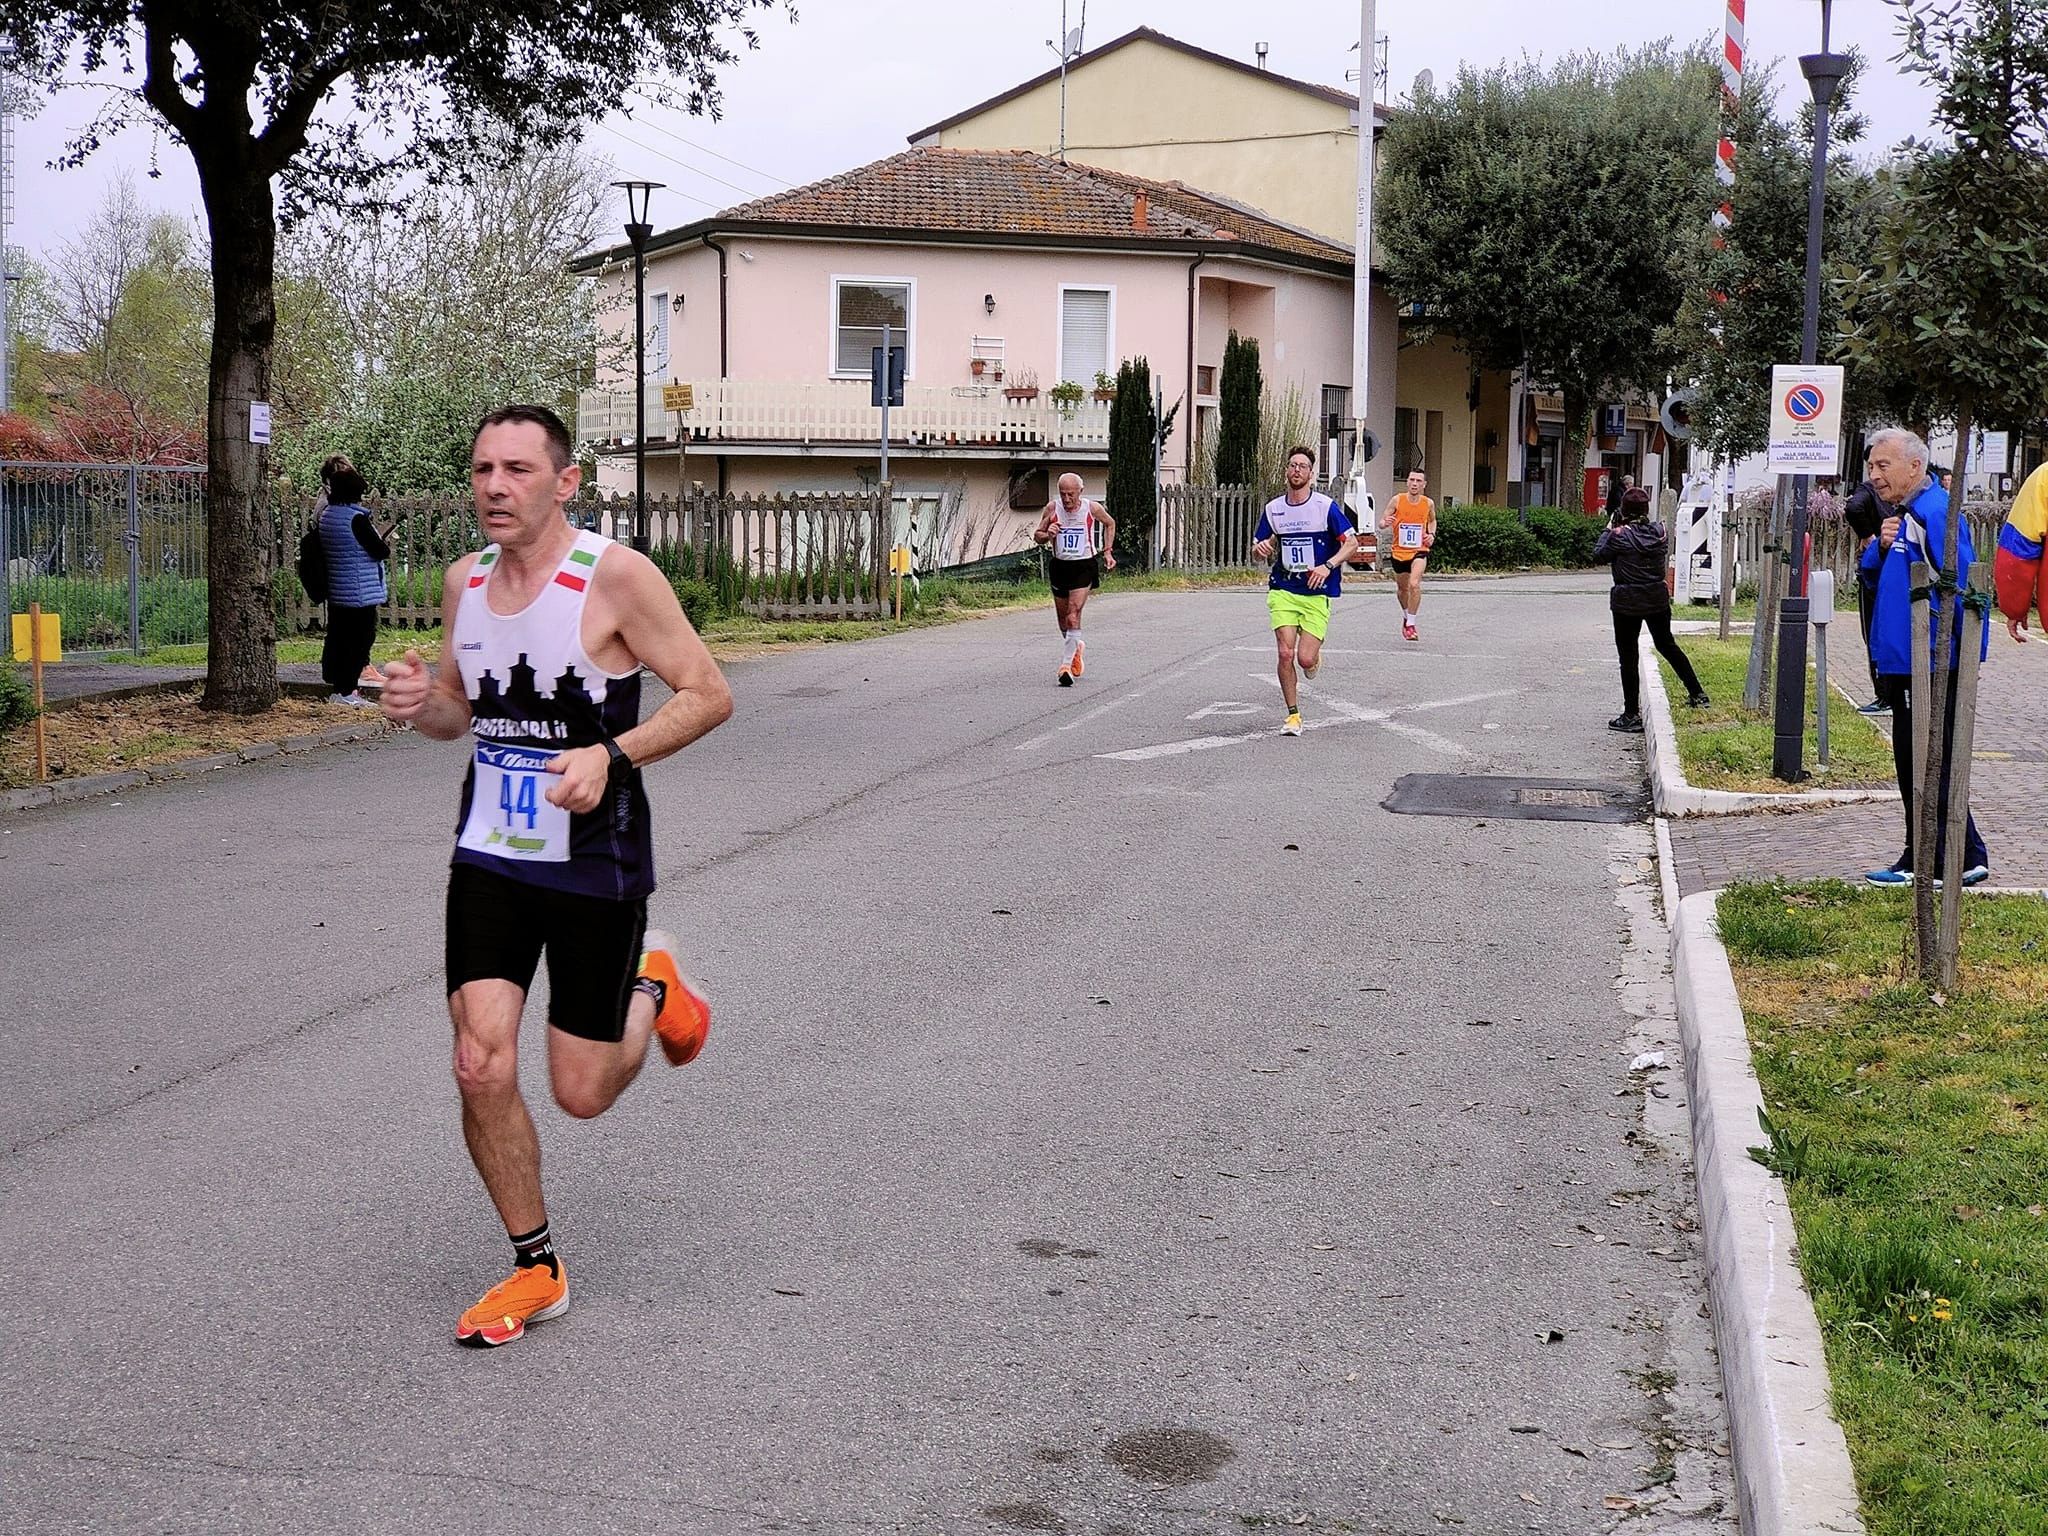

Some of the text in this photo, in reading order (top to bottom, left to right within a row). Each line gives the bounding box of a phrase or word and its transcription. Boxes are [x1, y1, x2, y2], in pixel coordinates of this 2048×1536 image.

[1063, 534, 1079, 549] 197
[1406, 530, 1416, 542] 61
[1291, 546, 1304, 564] 91
[499, 773, 537, 830] 44
